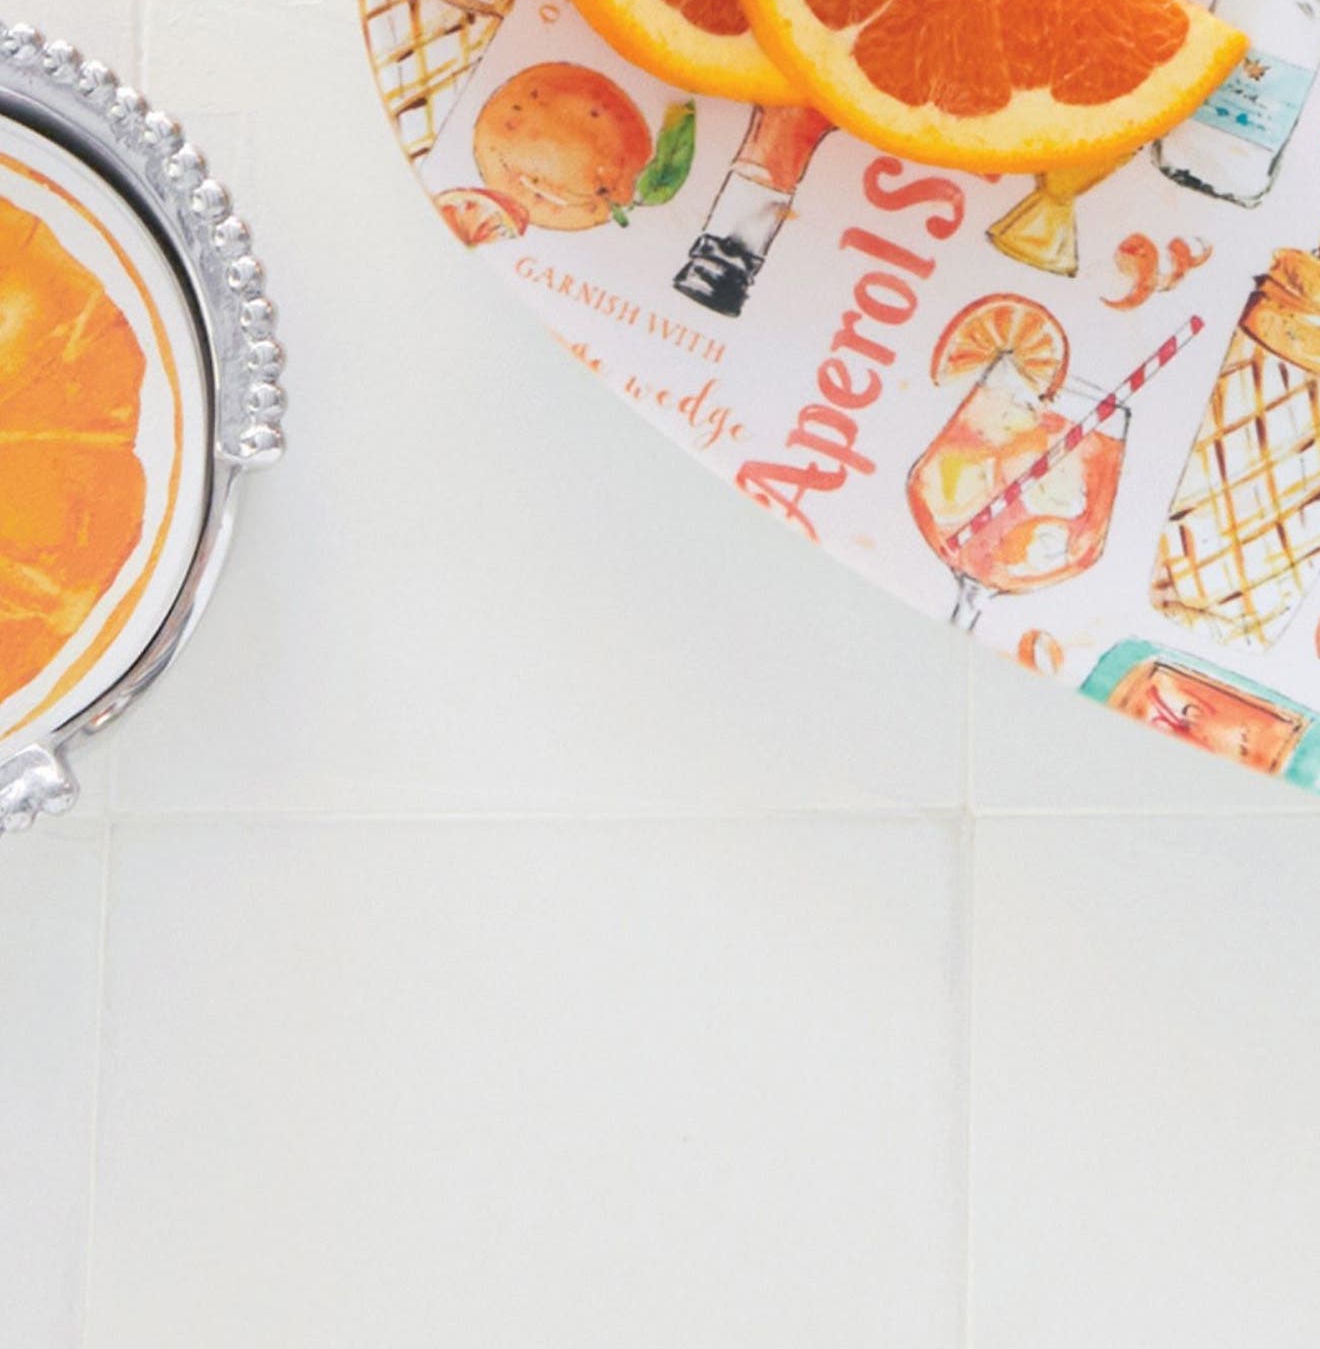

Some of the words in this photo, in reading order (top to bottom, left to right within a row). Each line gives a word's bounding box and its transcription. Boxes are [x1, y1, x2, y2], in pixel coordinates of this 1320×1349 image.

[514, 255, 641, 328] GARNISH
[647, 313, 727, 365] WITH
[735, 226, 937, 544] Aperol
